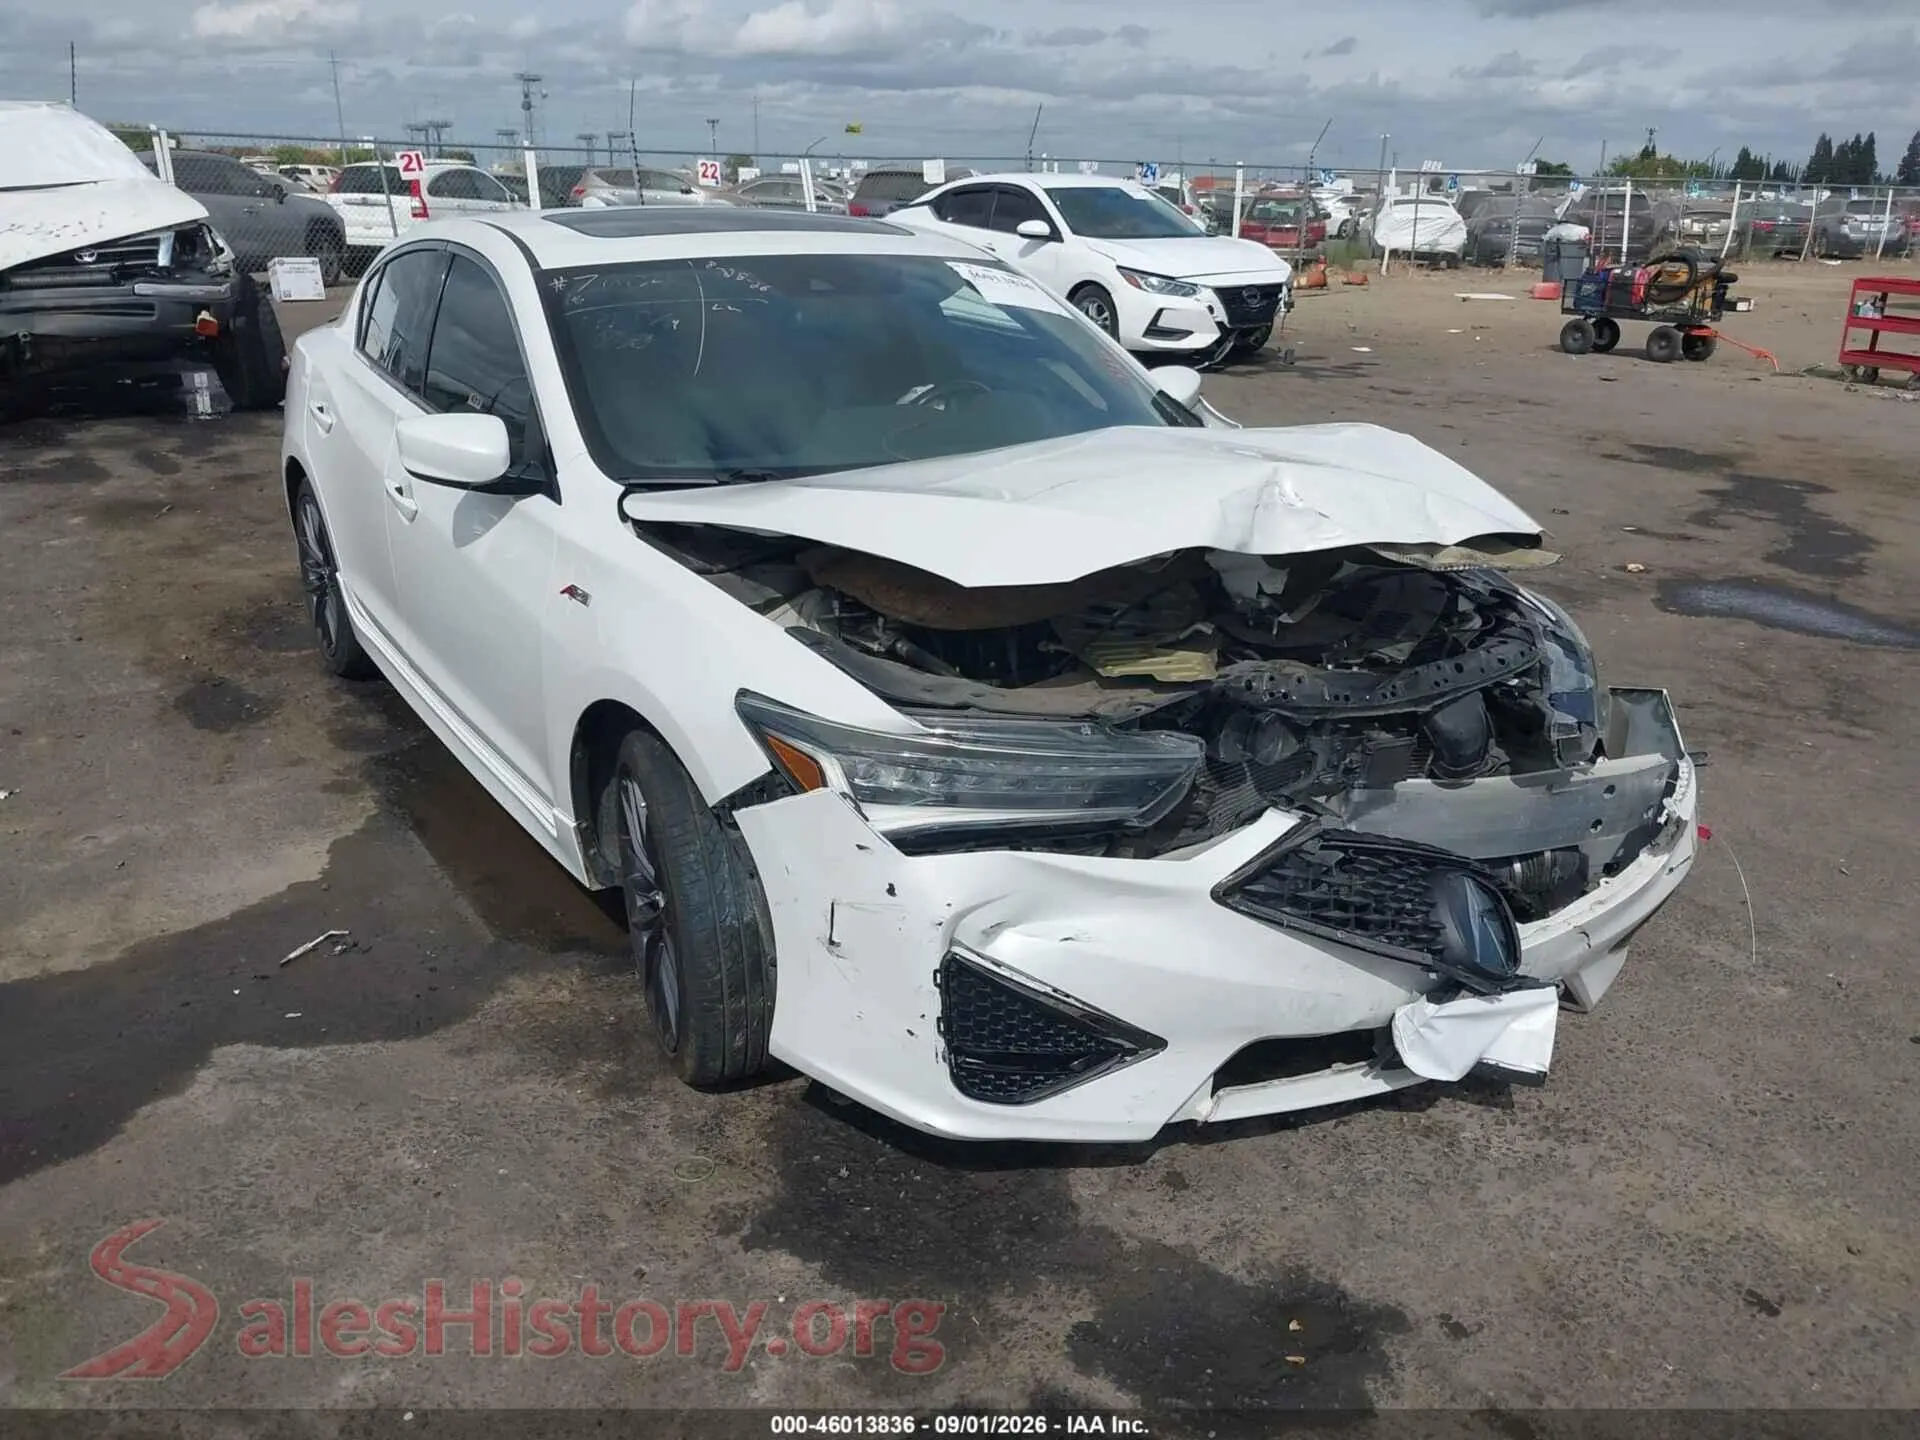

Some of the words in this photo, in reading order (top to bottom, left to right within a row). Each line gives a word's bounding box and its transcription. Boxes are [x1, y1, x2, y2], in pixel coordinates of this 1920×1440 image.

[400, 153, 424, 172] 21
[700, 162, 718, 180] 22
[1143, 162, 1157, 182] 24
